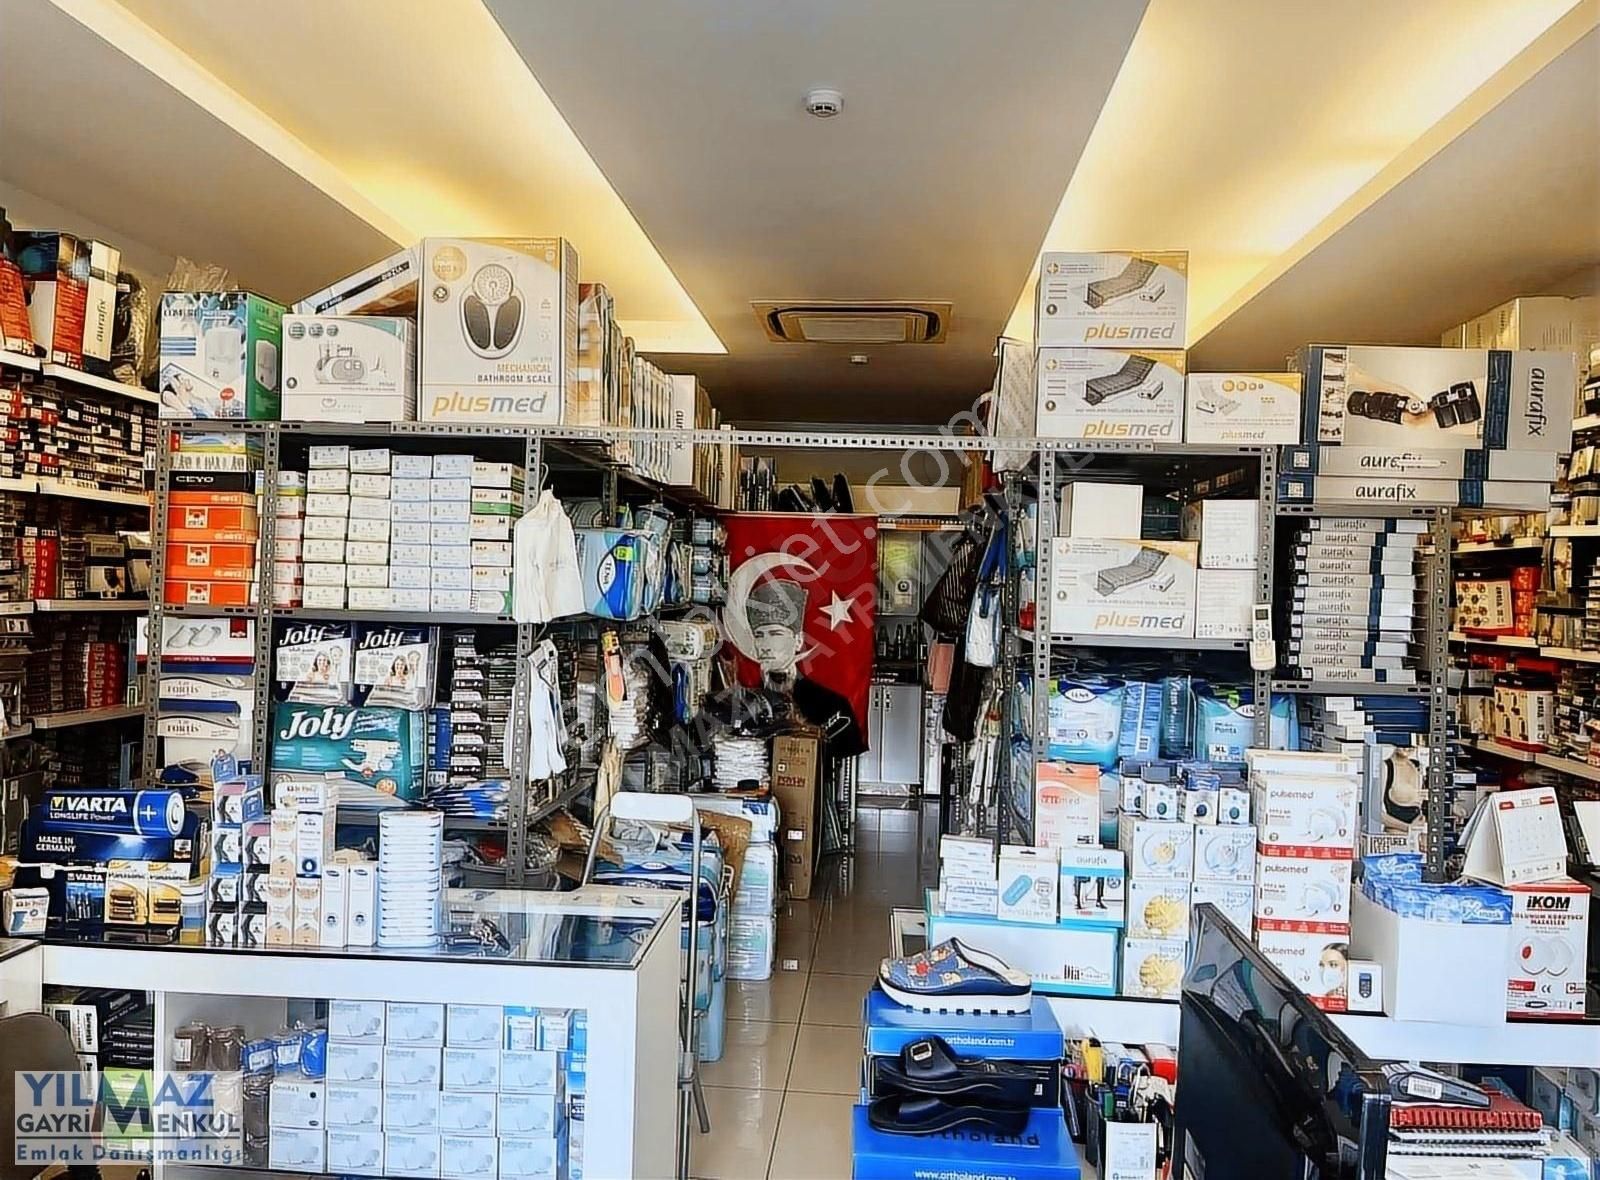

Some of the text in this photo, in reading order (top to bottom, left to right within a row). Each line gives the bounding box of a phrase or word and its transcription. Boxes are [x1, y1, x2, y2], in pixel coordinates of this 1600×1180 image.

[1084, 322, 1176, 342] plusmed
[496, 363, 552, 373] MECHANICAL
[477, 375, 552, 383] BATHROOM SCALE
[431, 391, 548, 417] plusmed
[1523, 367, 1546, 437] aurafix
[1083, 419, 1174, 439] plusmed
[1355, 483, 1417, 502] aurafix
[1094, 611, 1186, 630] plusmed
[279, 624, 328, 646] Joly
[360, 629, 404, 649] Joly
[280, 707, 358, 741] Joly
[66, 797, 127, 813] VARTA
[50, 812, 116, 821] LONGLIFE Power
[36, 844, 76, 852] GERMANY
[64, 836, 74, 844] IN
